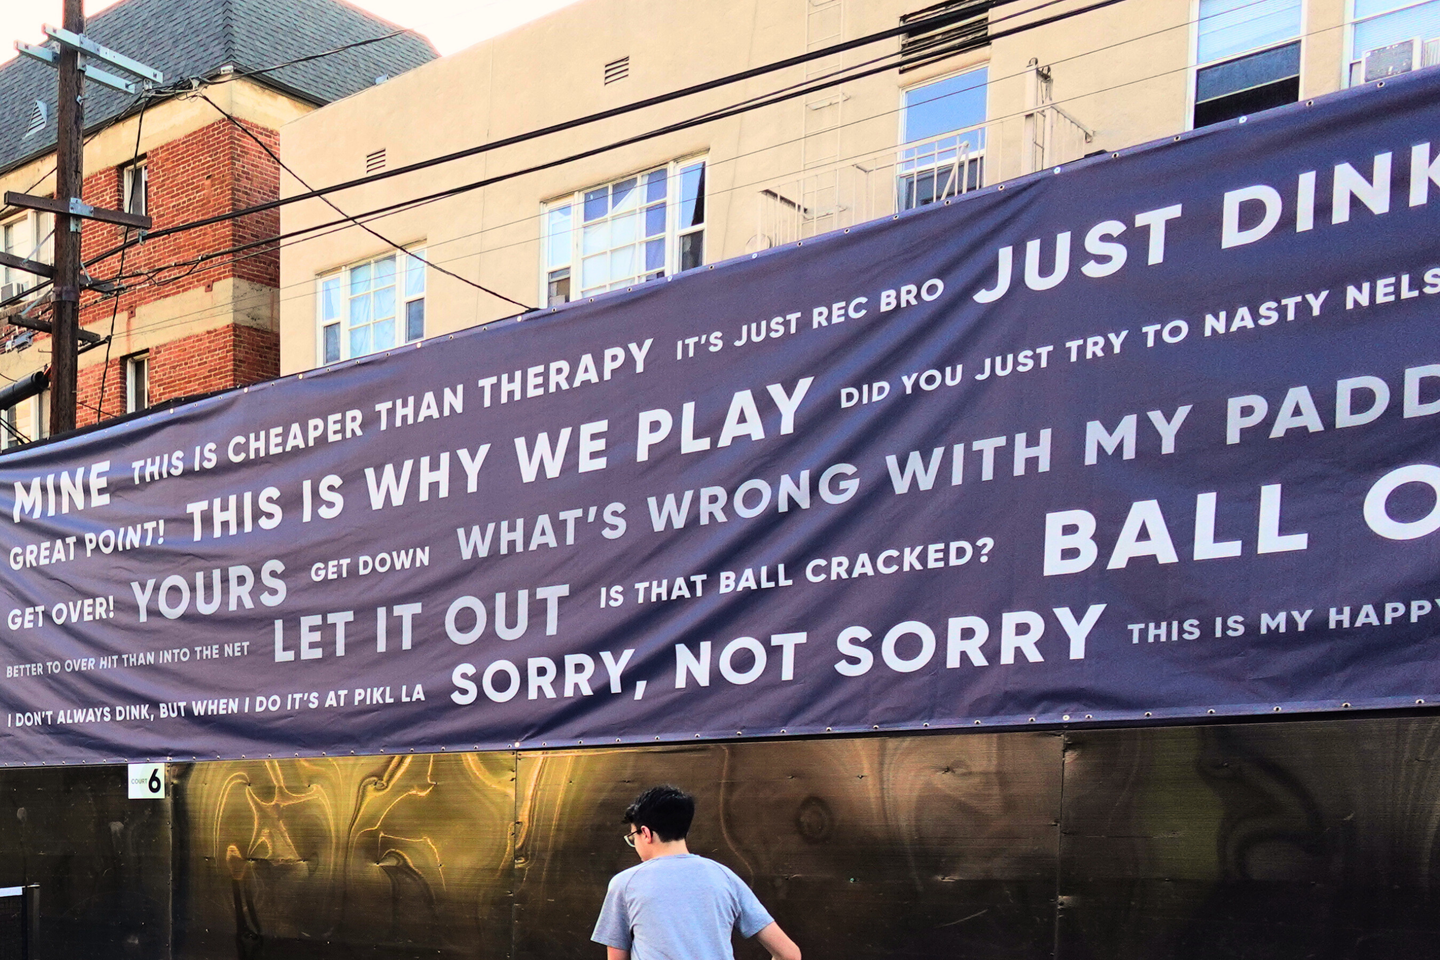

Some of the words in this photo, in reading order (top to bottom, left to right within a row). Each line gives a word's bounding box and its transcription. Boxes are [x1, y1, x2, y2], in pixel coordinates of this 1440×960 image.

[973, 204, 1182, 303] JUST
[677, 331, 723, 360] IT'S
[734, 312, 801, 346] JUST
[813, 297, 868, 329] REC
[880, 279, 944, 312] BRO
[841, 381, 890, 408] DID
[902, 364, 962, 394] YOU
[975, 345, 1053, 380] JUST
[1066, 330, 1128, 362] TRY
[1142, 320, 1188, 347] TO
[1205, 290, 1329, 337] NASTY
[132, 451, 184, 484] THIS
[194, 443, 217, 471] IS
[228, 410, 362, 462] CHEAPER
[375, 384, 463, 430] THAN
[478, 338, 653, 407] THERAPY
[13, 460, 110, 523] MINE
[187, 487, 282, 541] THIS
[303, 475, 343, 522] IS
[365, 444, 491, 510] WHY
[514, 420, 608, 483] WE
[637, 377, 814, 462] PLAY
[457, 502, 626, 560] WHAT'S
[647, 464, 860, 532] WRONG
[886, 428, 1051, 494] WITH
[1085, 405, 1193, 465] MY
[10, 536, 76, 570] GREAT
[85, 520, 164, 557] POINT!
[311, 558, 351, 581] GET
[359, 547, 429, 575] DOWN
[1044, 484, 1308, 576] BALL
[131, 560, 286, 622] YOURS
[600, 585, 623, 608] IS
[635, 574, 706, 603] THAT
[719, 564, 792, 594] BALL
[806, 537, 994, 582] CRACKED?
[8, 605, 44, 630] GET
[52, 596, 114, 624] OVER!
[275, 611, 353, 662] LET
[377, 603, 422, 652] IT
[445, 584, 569, 644] OUT
[1128, 619, 1200, 643] THIS
[1216, 615, 1244, 637] IS
[1261, 609, 1313, 634] MY
[7, 663, 43, 678] BETTER
[47, 661, 60, 673] TO
[64, 656, 96, 672] OVER
[99, 656, 118, 669] HIT
[122, 652, 154, 666] THAN
[160, 648, 189, 663] INTO
[195, 645, 219, 659] THE
[225, 642, 249, 657] NET
[451, 649, 646, 704] SORRY,
[675, 632, 807, 688] NOT
[835, 604, 1107, 676] SORRY
[8, 714, 12, 727] I
[16, 711, 53, 726] DON'T
[57, 707, 111, 724] ALWAYS
[116, 705, 154, 721] DINK,
[160, 702, 186, 718] BUT
[192, 698, 238, 715] WHEN
[245, 697, 250, 712] I
[256, 695, 280, 712] DO
[287, 692, 318, 710] IT'S
[325, 690, 348, 707] AT
[355, 687, 394, 705] PIKL
[402, 684, 425, 702] LA
[148, 768, 161, 793] 6
